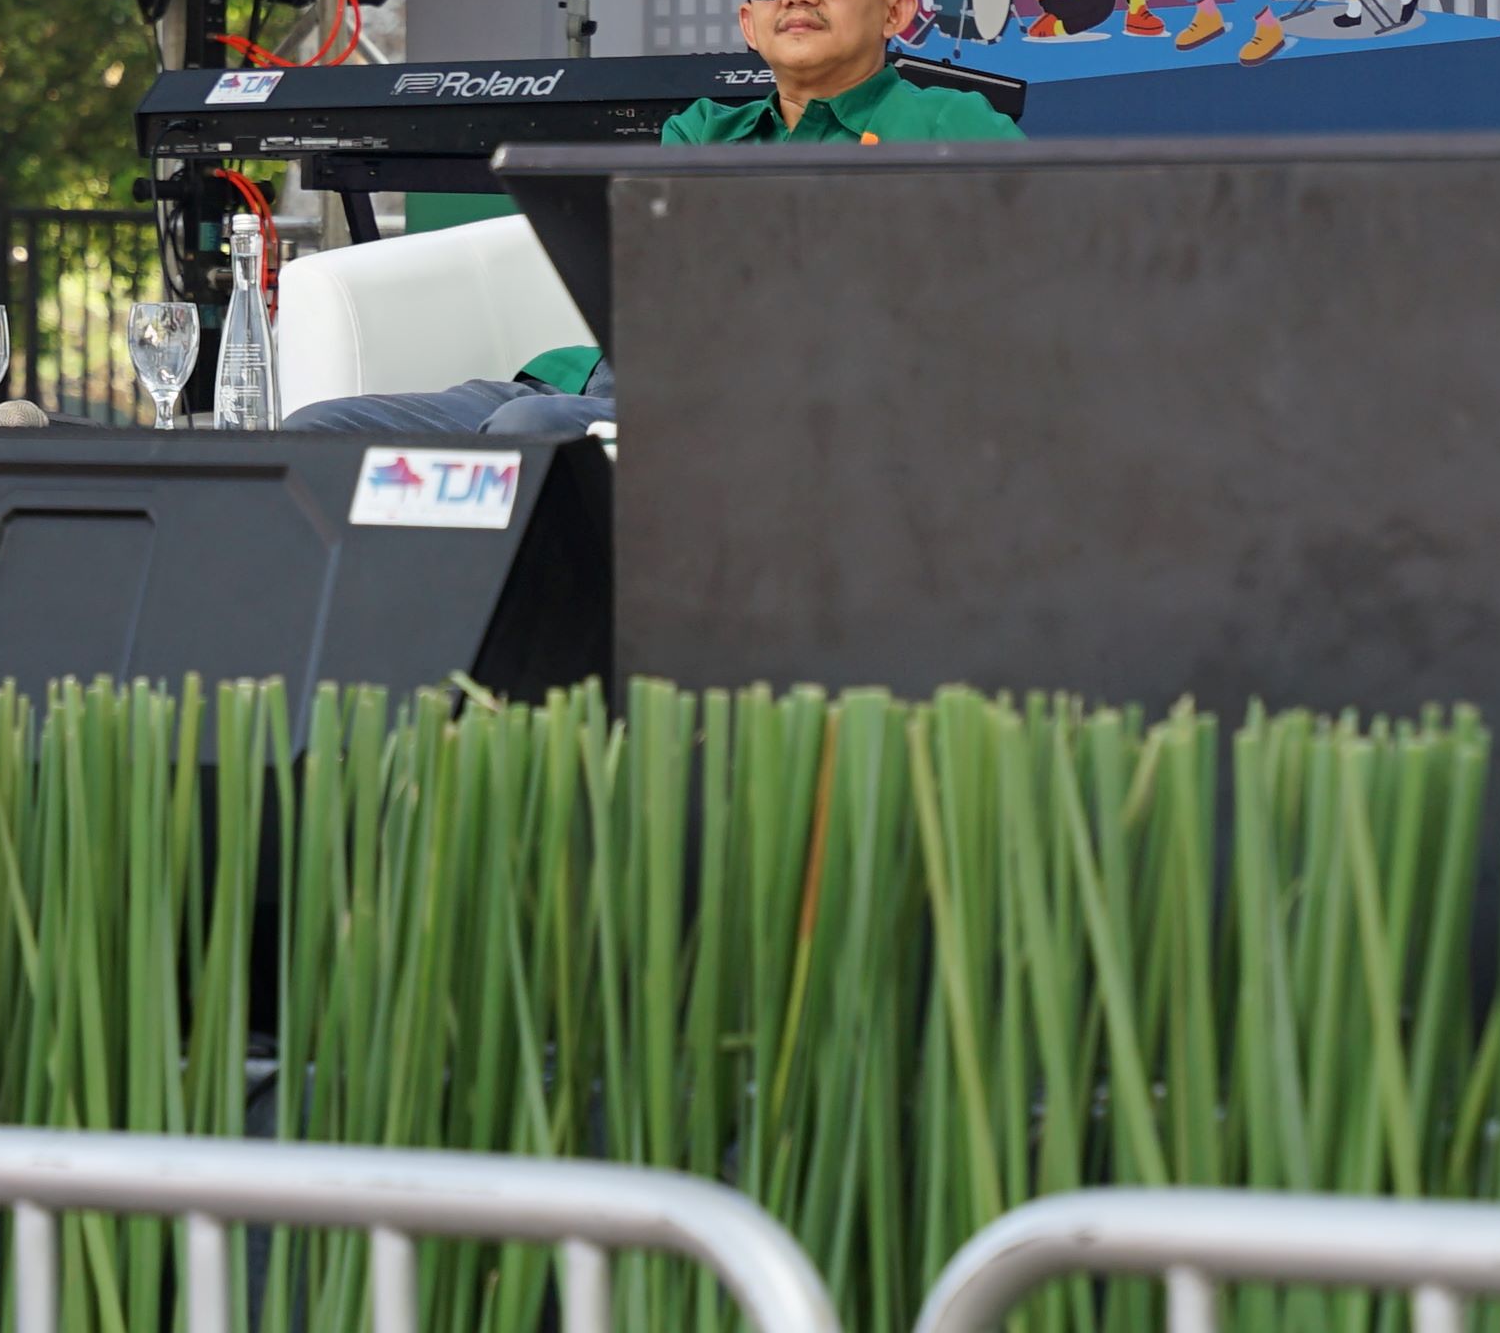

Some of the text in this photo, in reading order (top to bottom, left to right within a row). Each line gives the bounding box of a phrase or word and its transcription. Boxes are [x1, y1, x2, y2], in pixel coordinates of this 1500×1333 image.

[241, 75, 280, 94] TJM
[436, 68, 565, 97] Roland
[431, 461, 517, 505] TJM
